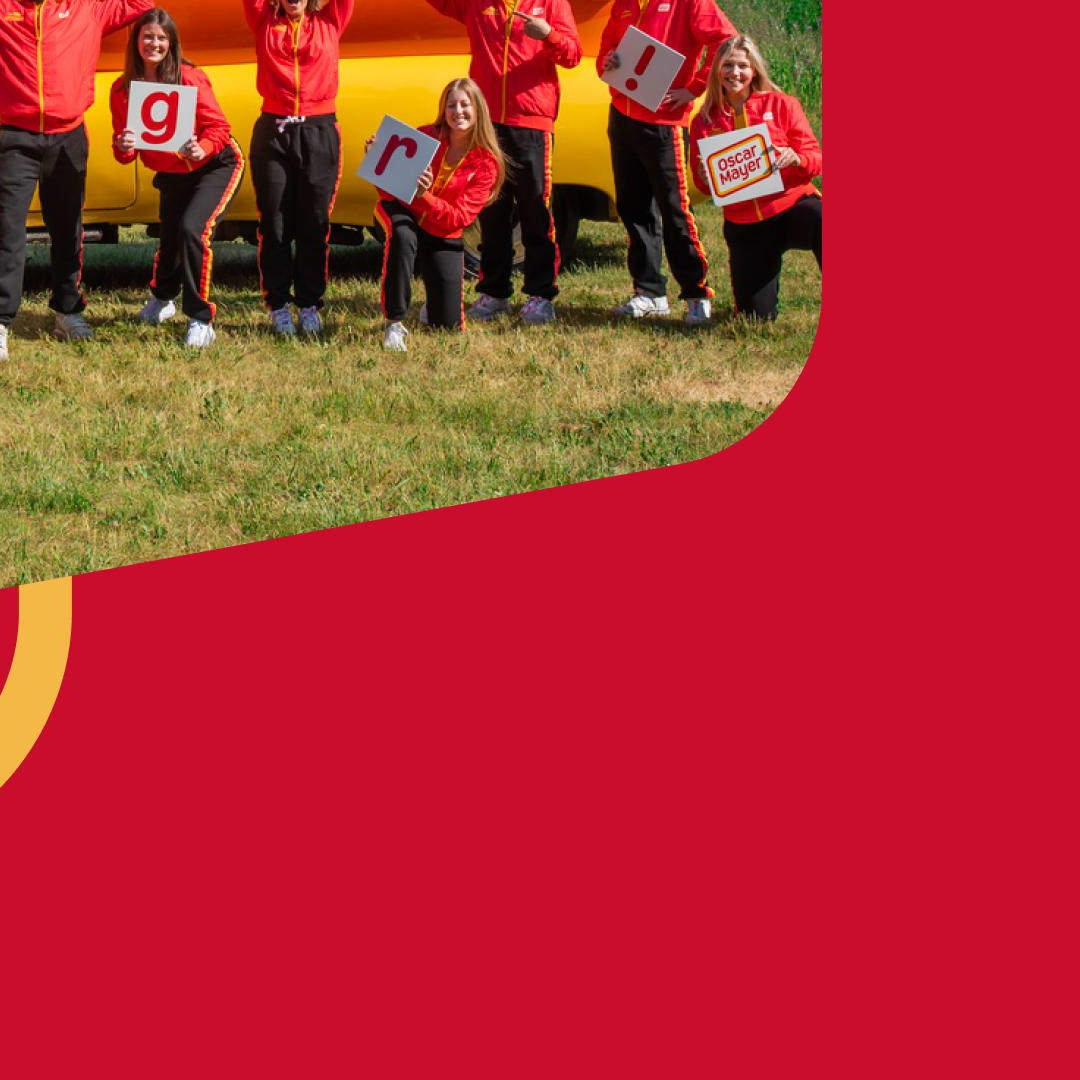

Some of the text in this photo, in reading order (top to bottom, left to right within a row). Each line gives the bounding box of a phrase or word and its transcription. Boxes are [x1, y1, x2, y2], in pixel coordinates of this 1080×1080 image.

[624, 44, 656, 92] !
[140, 90, 180, 145] g
[373, 133, 418, 177] r
[717, 144, 757, 172] Oscar
[719, 156, 762, 186] Mayer
